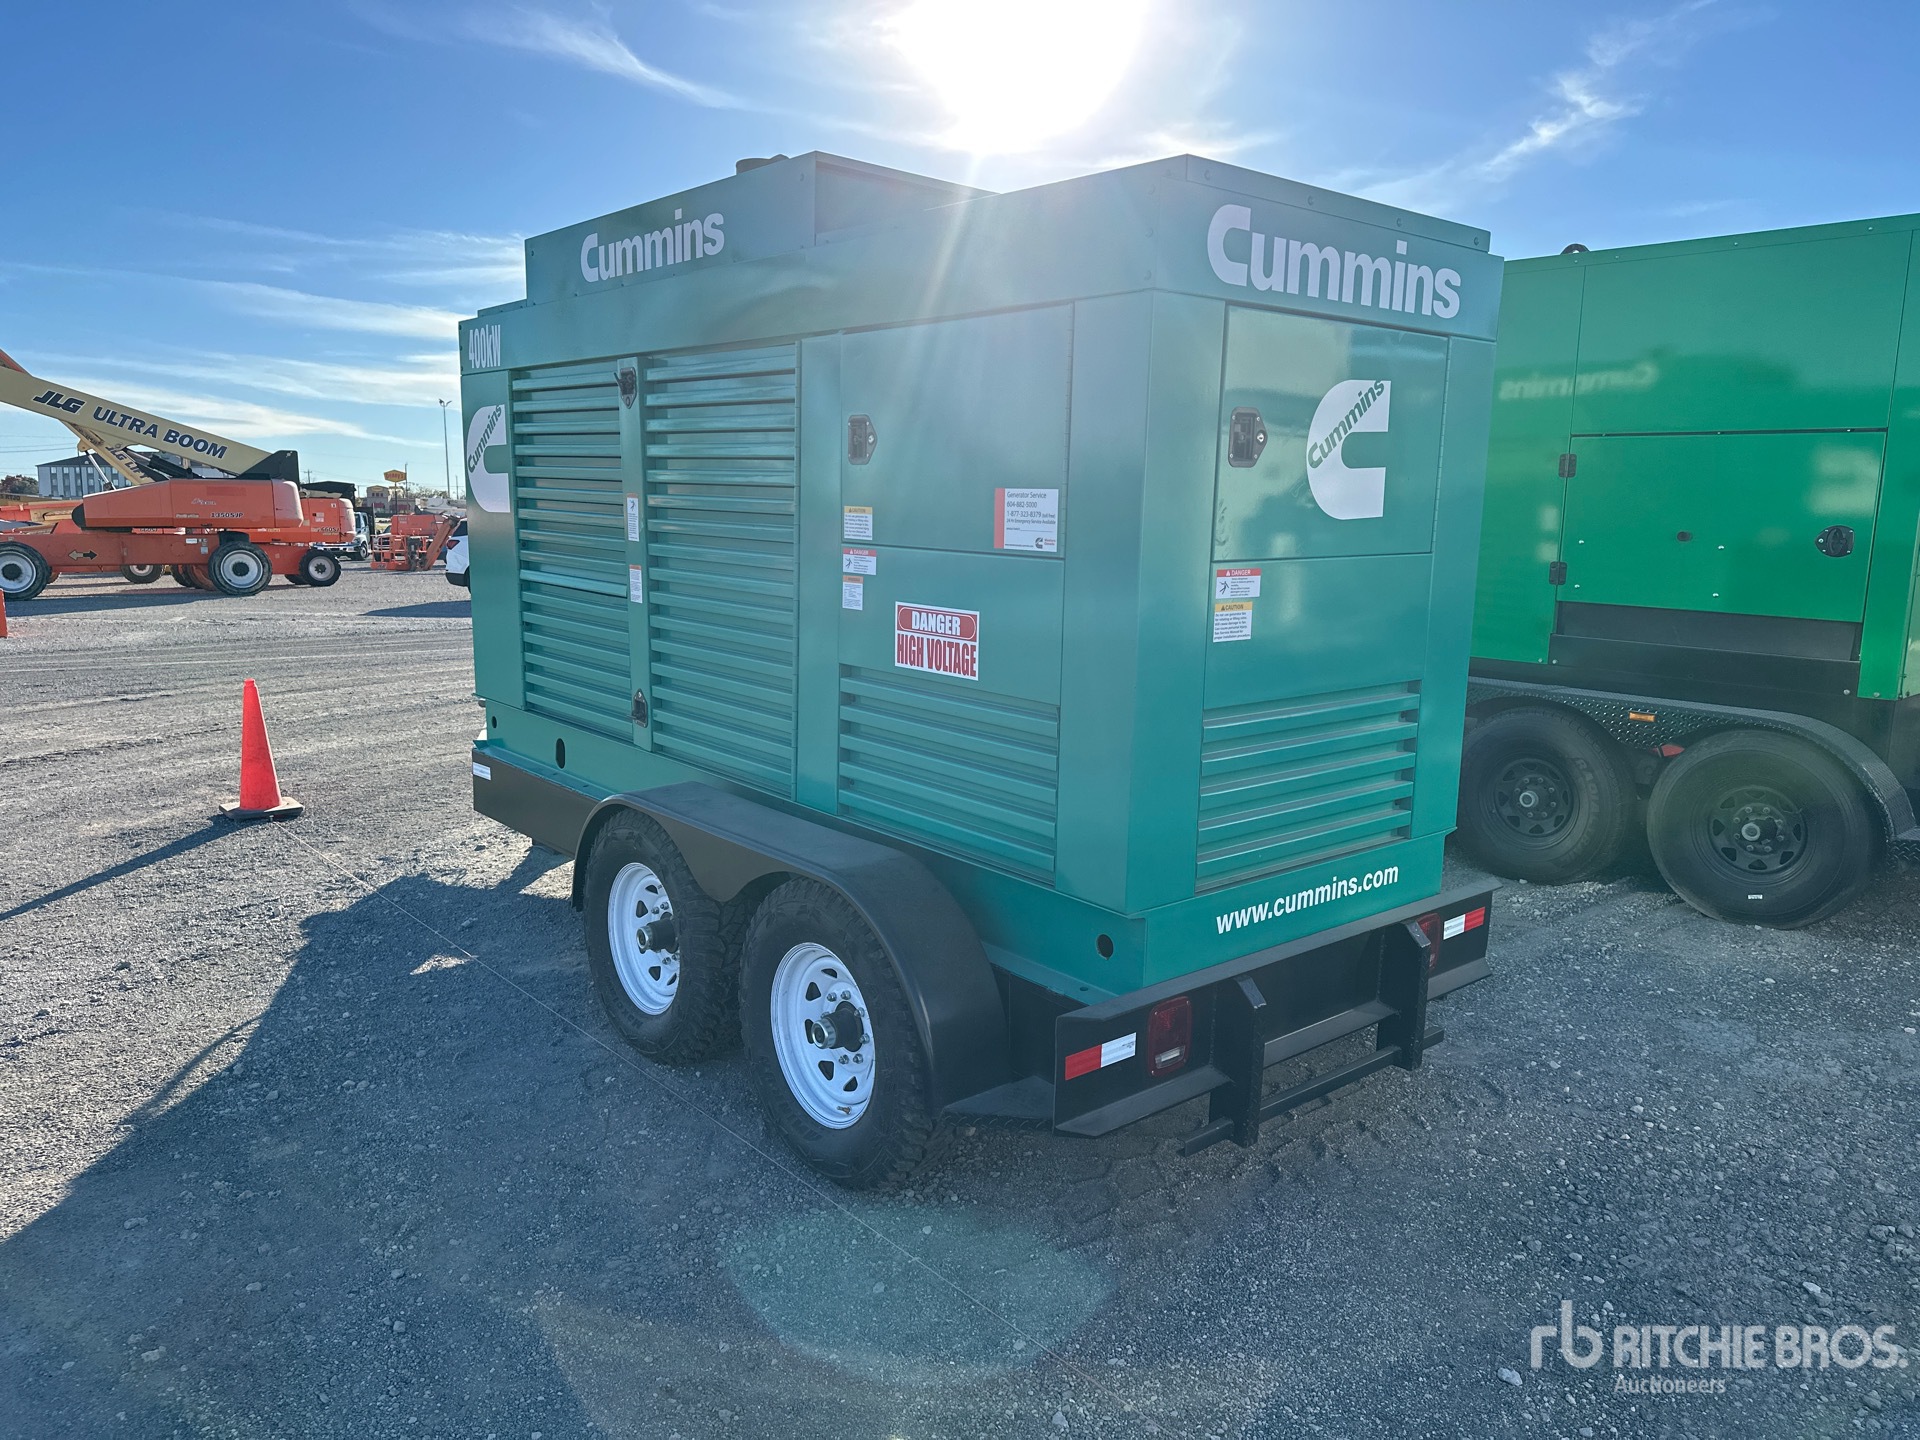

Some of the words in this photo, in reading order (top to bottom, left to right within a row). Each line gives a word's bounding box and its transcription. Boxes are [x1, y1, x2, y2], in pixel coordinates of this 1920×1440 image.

[580, 208, 725, 283] Cummins
[1207, 204, 1461, 319] Cummins
[468, 324, 501, 369] 400kW
[32, 390, 86, 414] JLG
[92, 406, 158, 439] ULTRA
[163, 428, 228, 459] BOOM
[466, 404, 502, 474] Cummins
[1307, 379, 1385, 469] Cummins
[896, 633, 924, 668] HIGH
[926, 637, 977, 677] VOLTAGE
[911, 610, 961, 636] DANGER
[1215, 865, 1399, 935] www.cummins.com
